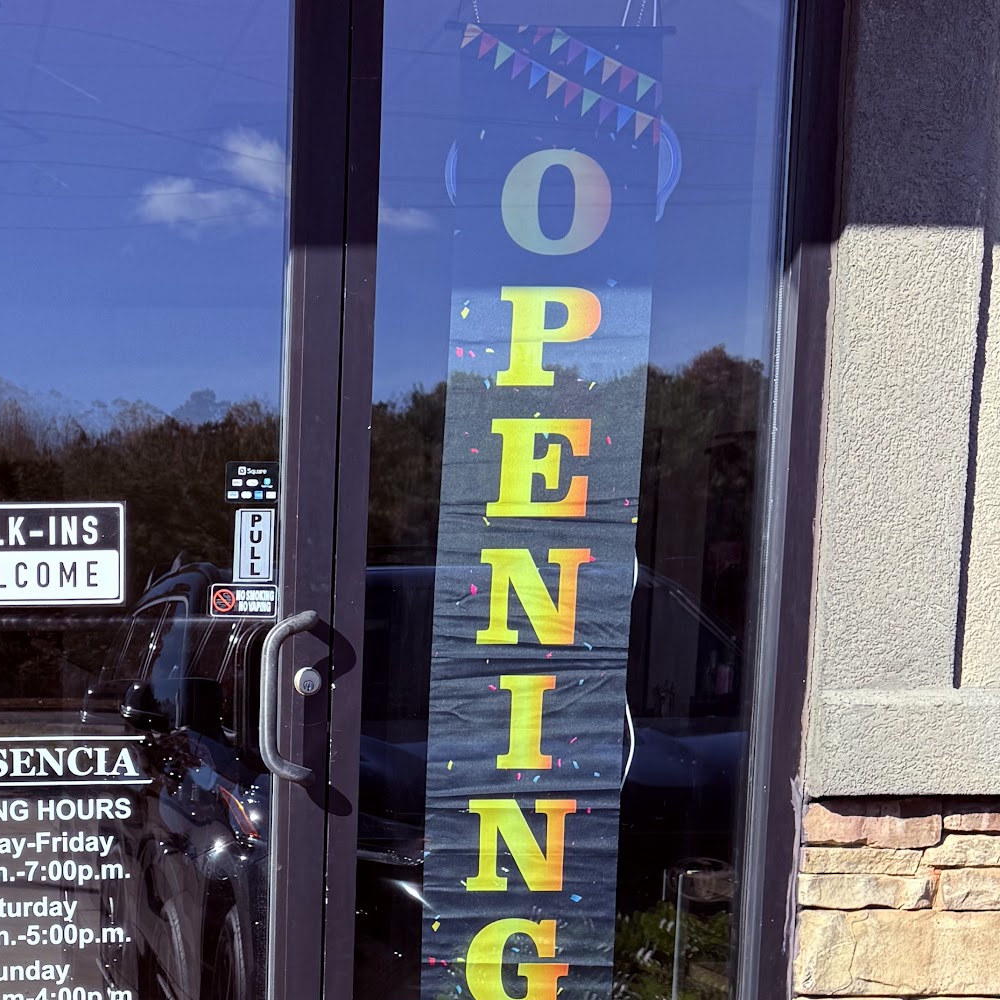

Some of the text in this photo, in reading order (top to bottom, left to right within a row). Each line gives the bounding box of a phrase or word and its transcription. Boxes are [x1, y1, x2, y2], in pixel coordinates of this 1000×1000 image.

[249, 514, 263, 576] PULL
[235, 589, 275, 602] NO SMOKING
[238, 601, 272, 613] NO VAPING
[37, 797, 132, 821] HOURS
